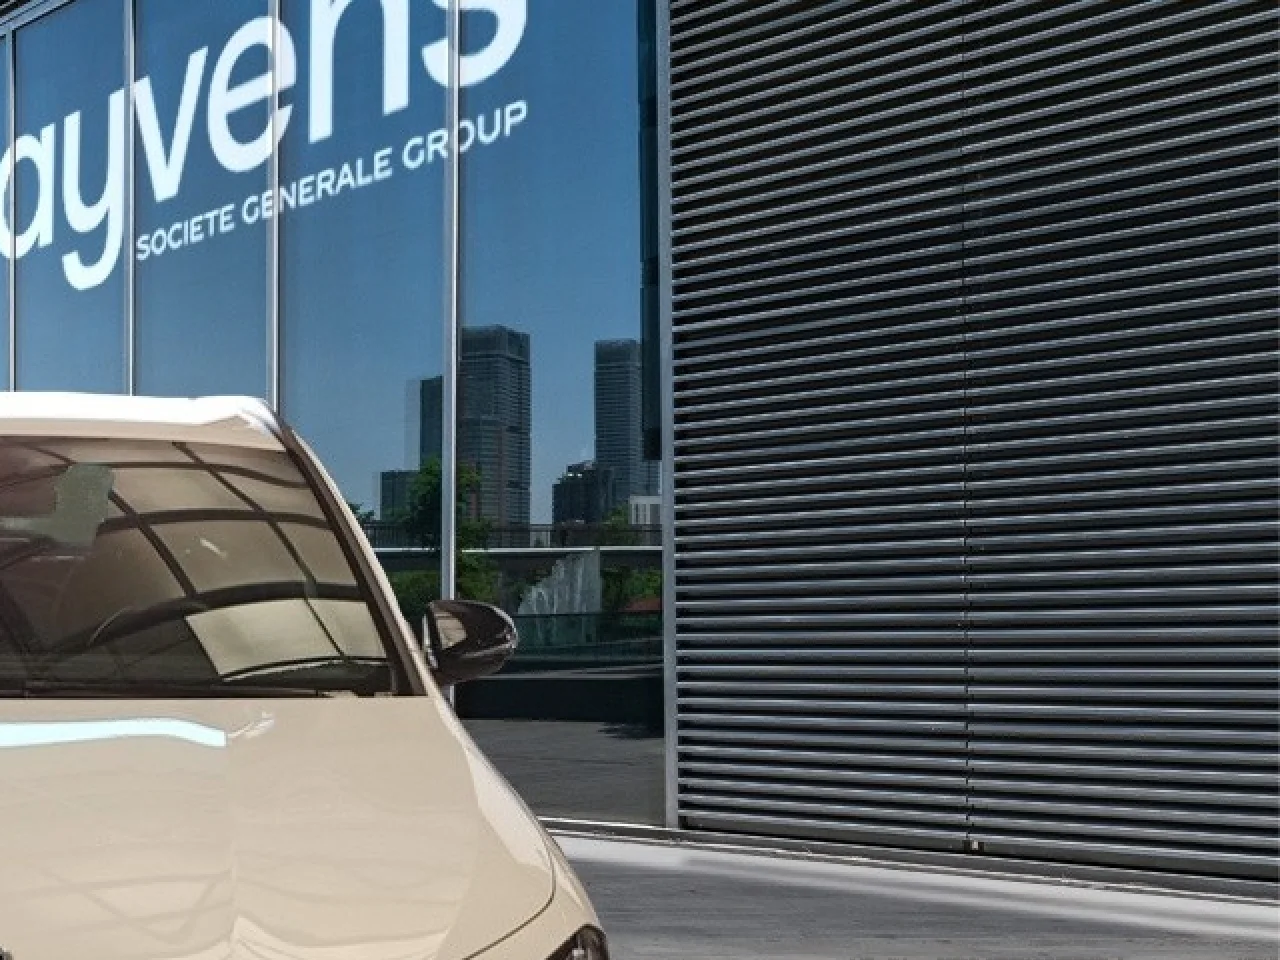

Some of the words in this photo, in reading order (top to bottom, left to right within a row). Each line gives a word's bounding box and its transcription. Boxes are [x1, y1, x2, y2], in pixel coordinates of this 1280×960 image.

[135, 203, 236, 261] SOCIETE
[241, 147, 394, 225] GENERALE
[401, 99, 528, 170] GROUP
